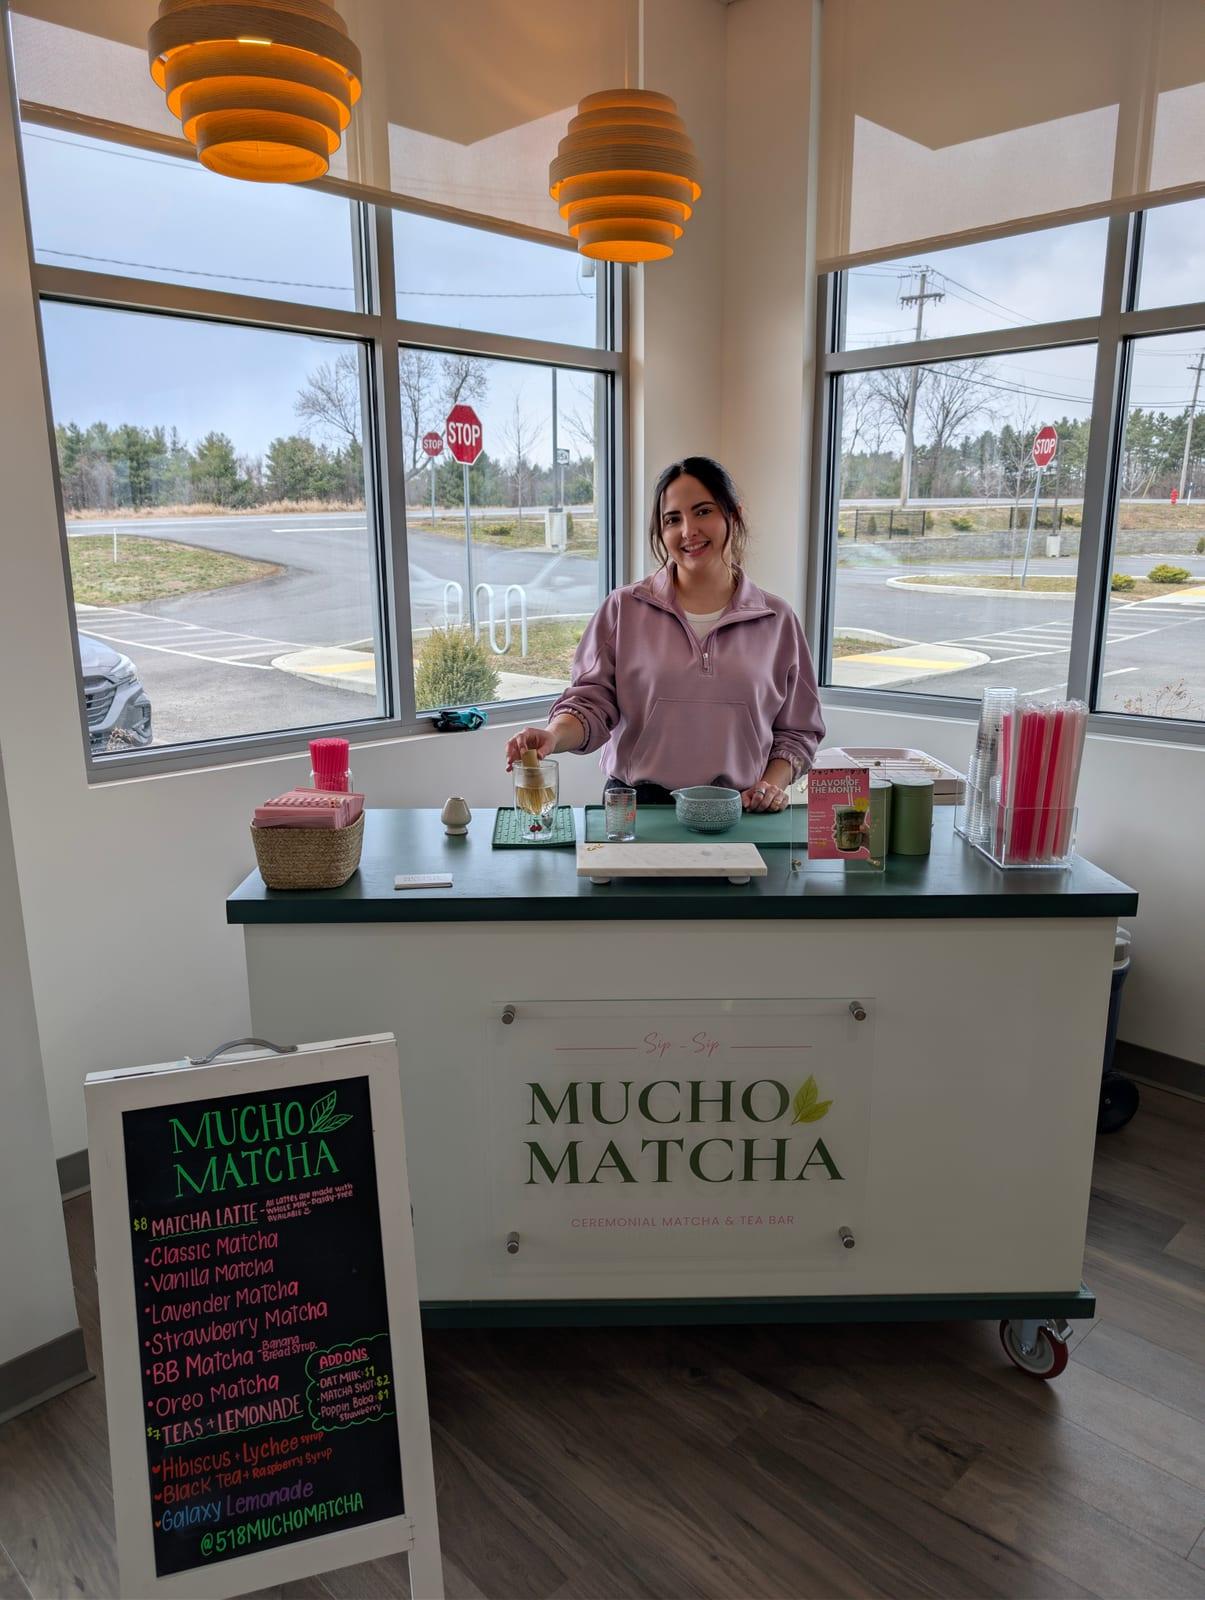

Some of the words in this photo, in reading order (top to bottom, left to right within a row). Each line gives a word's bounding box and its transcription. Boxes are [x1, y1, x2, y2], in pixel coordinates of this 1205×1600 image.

[423, 438, 443, 450] STOP
[448, 422, 481, 447] STOP
[1034, 438, 1056, 455] STOP
[810, 786, 827, 794] THE
[828, 786, 861, 794] MONTH
[811, 779, 848, 787] FLAVOR
[849, 778, 860, 787] OF
[643, 1031, 672, 1057] Sip
[692, 1031, 720, 1057] Sip
[525, 1079, 791, 1125] MUCHO
[169, 1100, 305, 1155] MUCHO
[173, 1138, 340, 1198] MATCHA
[523, 1137, 847, 1185] MATCHA
[133, 1217, 148, 1232] $8
[151, 1210, 212, 1238] MATCHA
[216, 1203, 259, 1226] LATTE
[571, 1217, 656, 1228] CEREMONIAL
[662, 1216, 720, 1227] MATCHA
[724, 1216, 735, 1226] &
[739, 1215, 763, 1226] TEA
[768, 1215, 795, 1225] BAR
[151, 1244, 211, 1267] Classic
[216, 1230, 279, 1257] Matcha
[150, 1267, 209, 1293] Vanilla
[215, 1259, 274, 1286] Matcha
[151, 1293, 231, 1325] Lavender
[236, 1280, 299, 1308] Matcha
[151, 1317, 259, 1355] Strawberry
[264, 1300, 329, 1332] Matcha
[153, 1359, 180, 1385] BB
[185, 1348, 254, 1379] Matcha
[319, 1354, 342, 1370] ADD
[343, 1347, 368, 1362] ONS
[156, 1392, 204, 1417] Oreo
[210, 1374, 280, 1404] Matcha
[320, 1374, 338, 1389] OAT
[320, 1384, 353, 1402] MATCHA
[376, 1374, 391, 1387] $2
[162, 1418, 203, 1446] TEAS
[217, 1394, 304, 1433] LEMONADE
[162, 1451, 231, 1482] Hibiscus
[242, 1436, 299, 1466] Lychee
[162, 1476, 212, 1505] Black
[216, 1468, 242, 1488] Tea
[252, 1455, 303, 1479] Raspberry
[161, 1497, 222, 1533] Galaxy
[226, 1480, 315, 1517] Lemonade
[200, 1492, 364, 1557] @518MUCHOMATCHA
